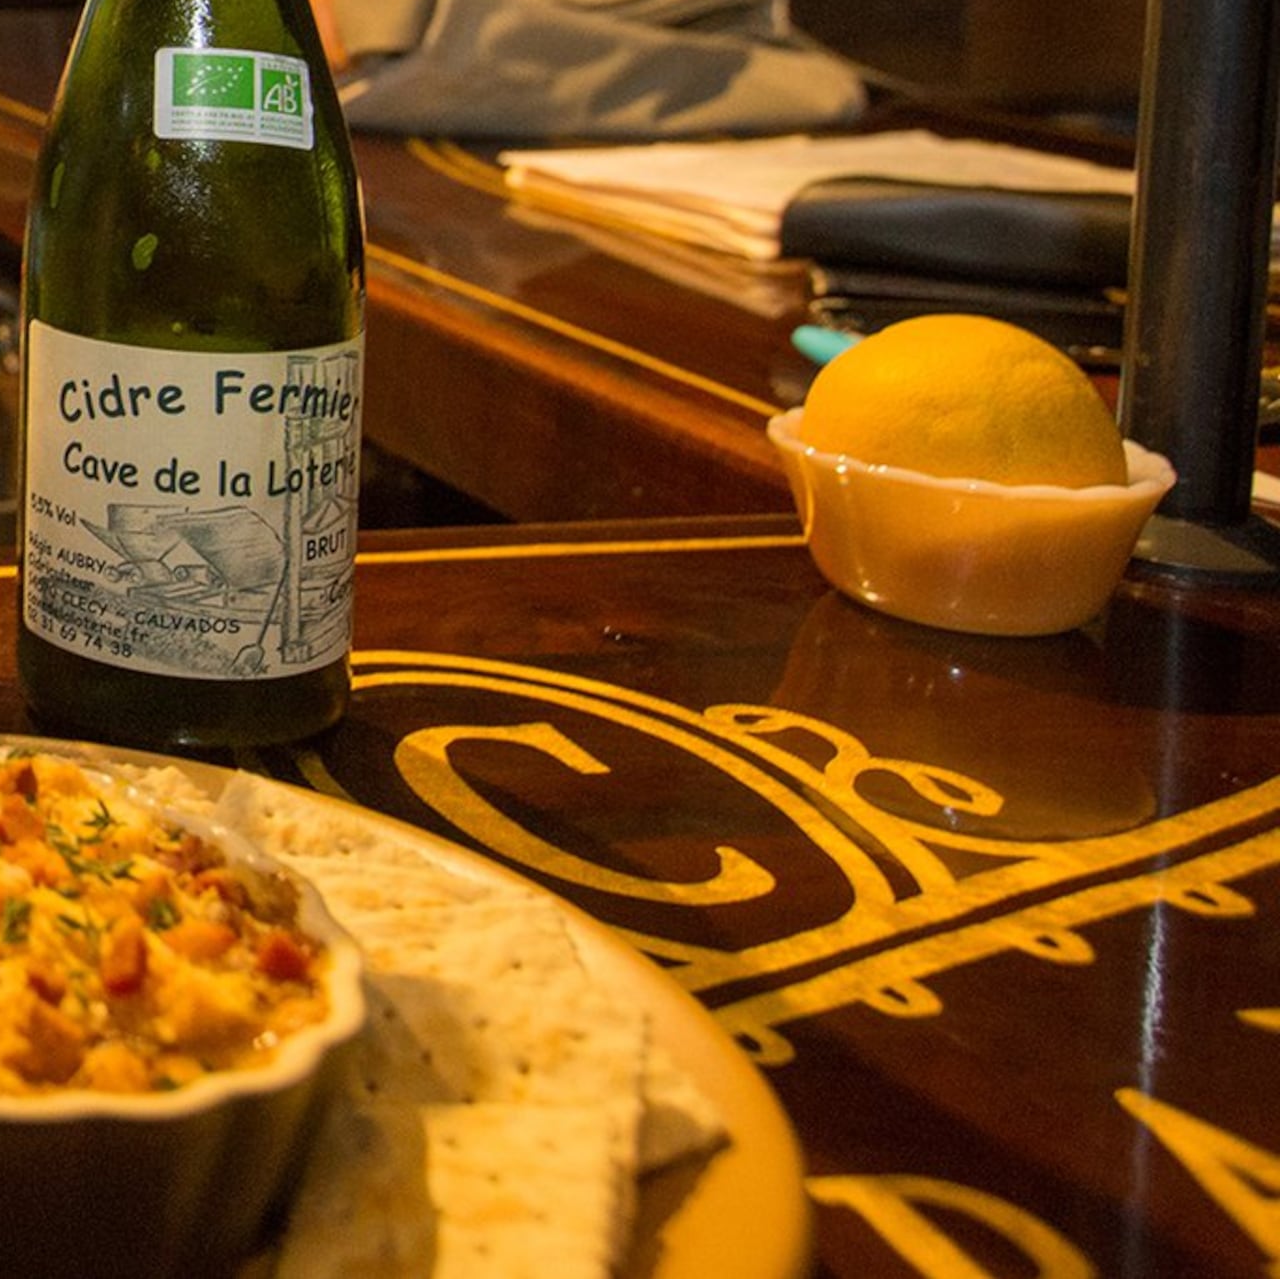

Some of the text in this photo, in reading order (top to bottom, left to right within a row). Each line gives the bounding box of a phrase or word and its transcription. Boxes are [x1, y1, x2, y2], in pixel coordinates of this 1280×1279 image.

[59, 374, 186, 423] Cidre
[63, 442, 138, 488] Cave
[154, 457, 200, 495] de
[219, 461, 252, 497] la
[306, 529, 347, 561] BRUT
[57, 547, 106, 576] AUBRY
[135, 611, 241, 634] CALVADOS
[83, 632, 103, 651] 74
[111, 640, 132, 658] 38
